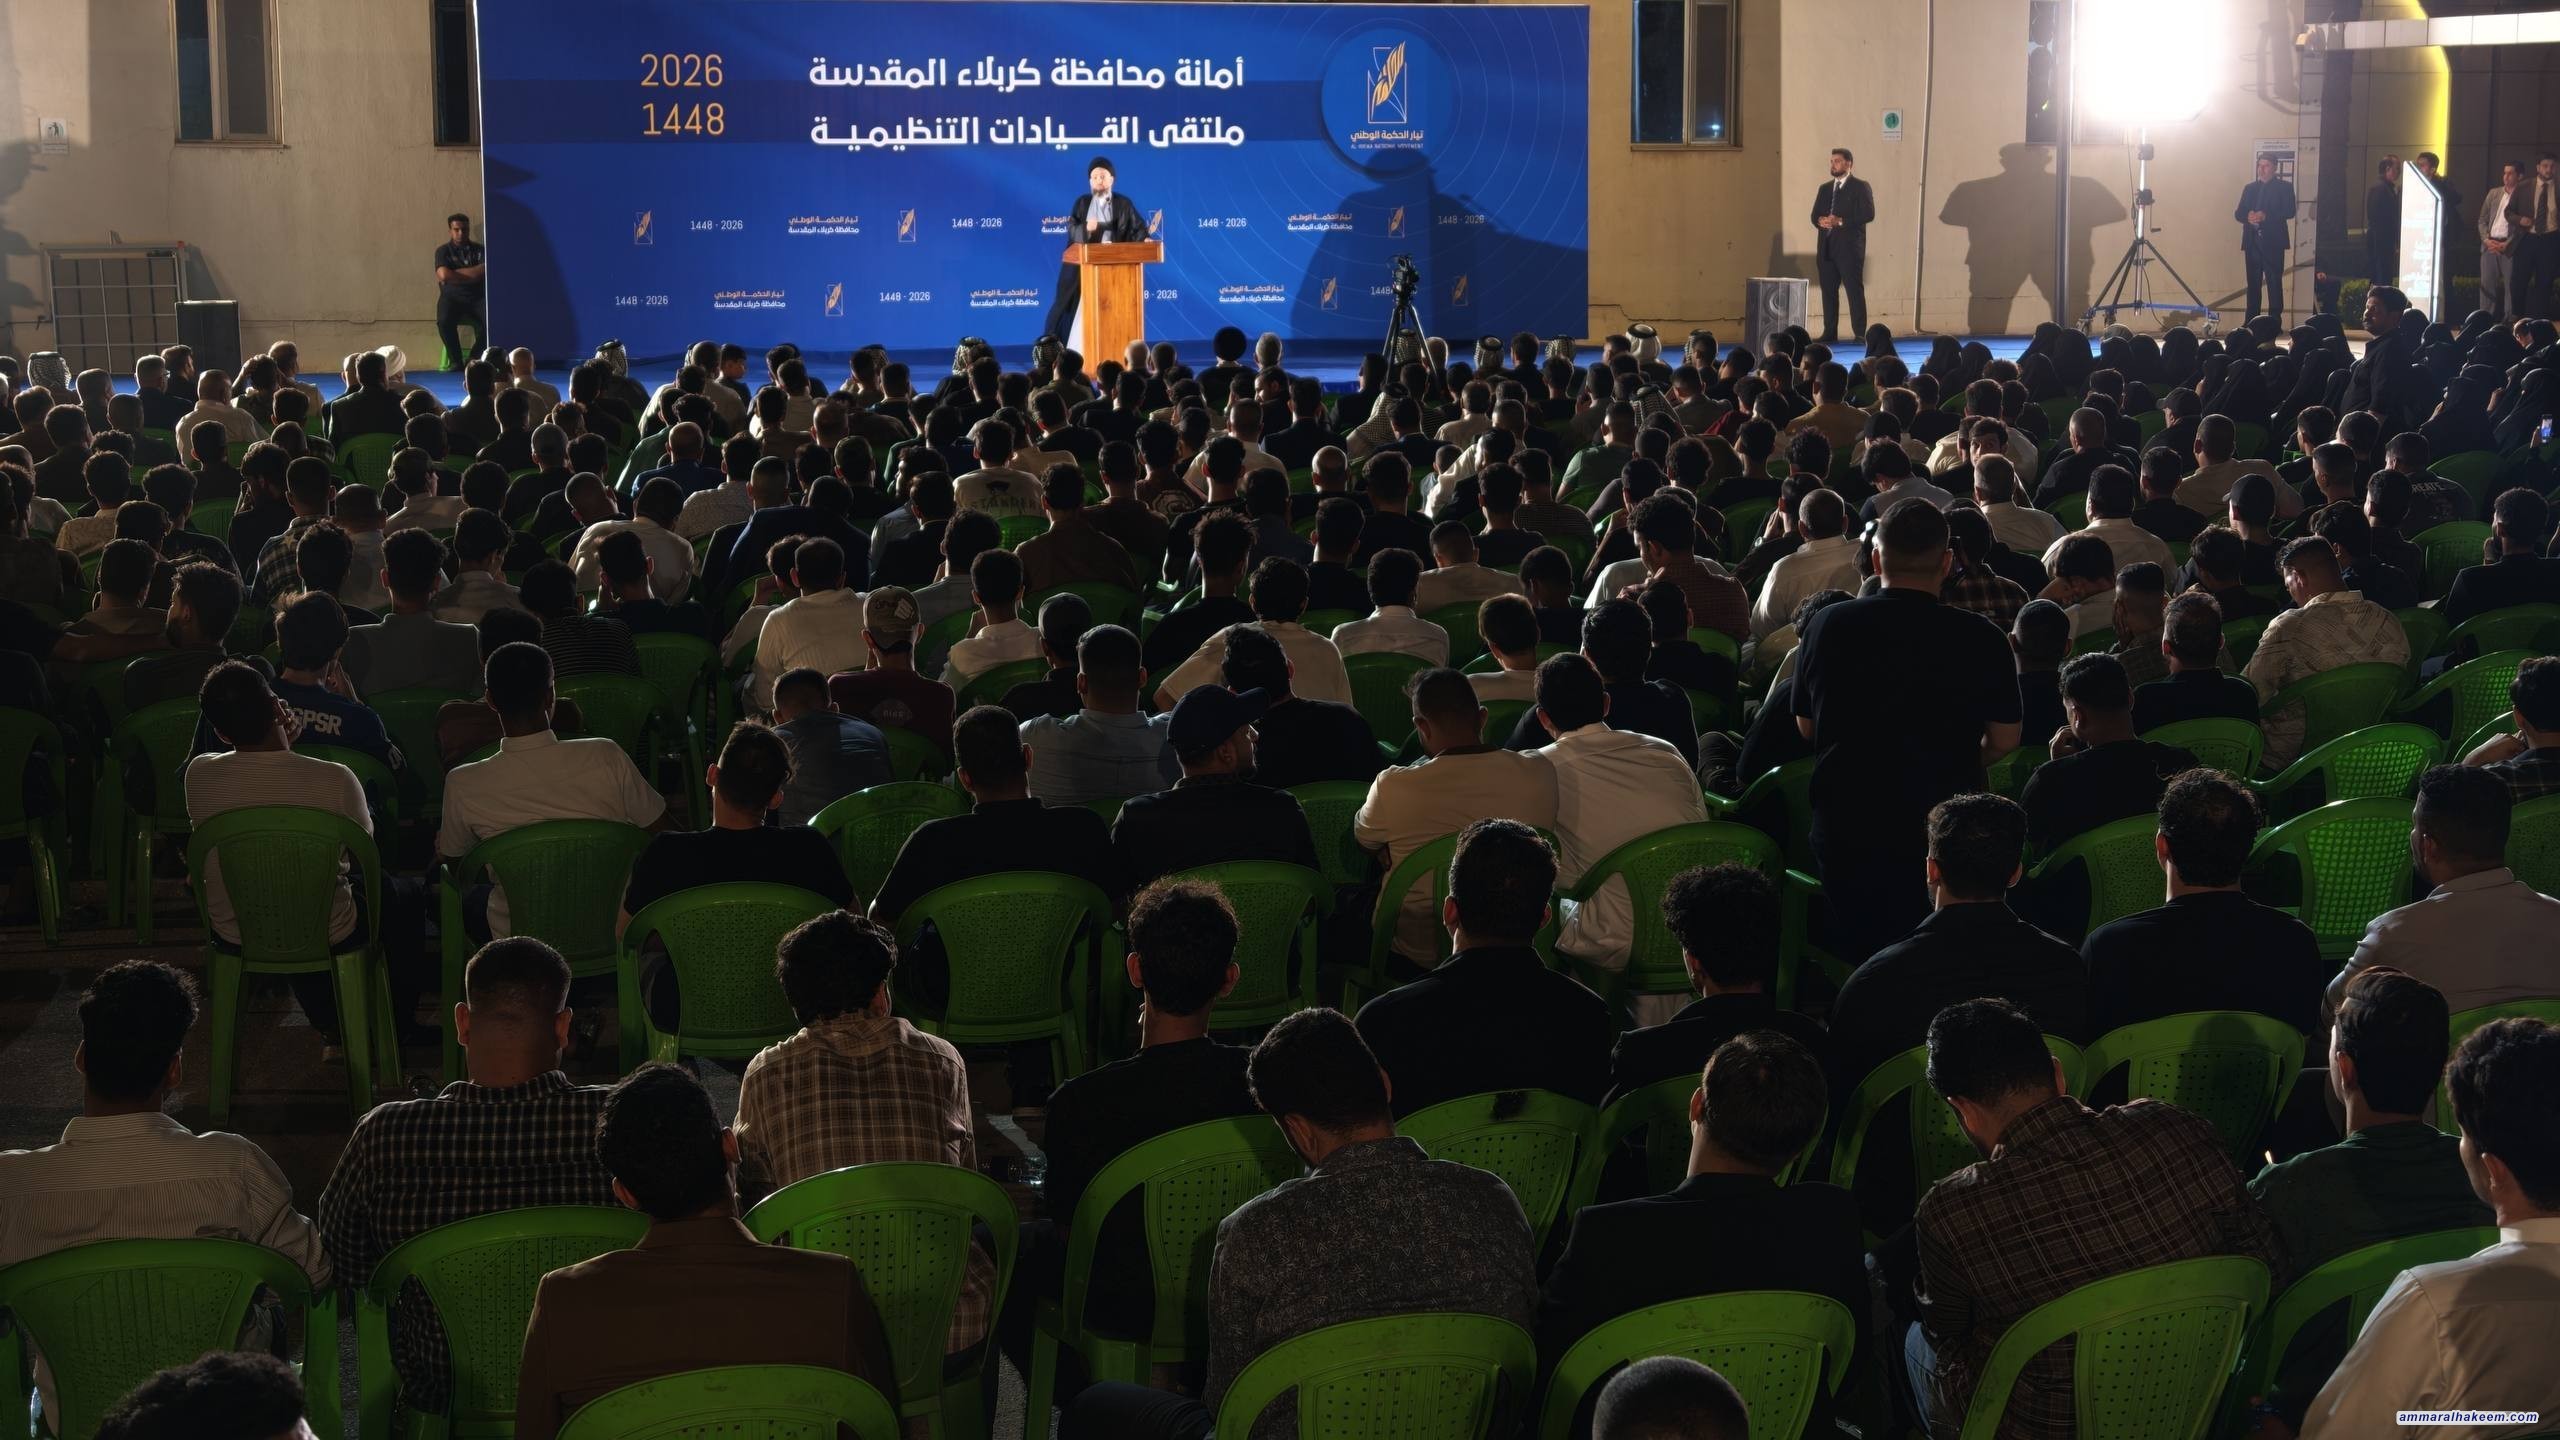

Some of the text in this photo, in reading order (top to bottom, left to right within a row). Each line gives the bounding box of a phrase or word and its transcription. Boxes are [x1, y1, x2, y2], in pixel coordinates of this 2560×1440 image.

[640, 53, 723, 87] 2026
[809, 55, 1244, 93] أمانة محافظة كربلاء المقدسة
[642, 102, 725, 136] 1448
[1148, 116, 1245, 148] ملتقى
[1350, 130, 1424, 142] تيار الحكمة الوطني
[690, 219, 744, 231] 1448 2026
[952, 217, 1003, 229] 1448 2026
[1198, 217, 1247, 228] 1448 2026
[879, 291, 931, 302] 1448 2026
[1156, 289, 1178, 300] 2026
[1370, 286, 1391, 296] 1448
[615, 295, 669, 306] 1448 2026
